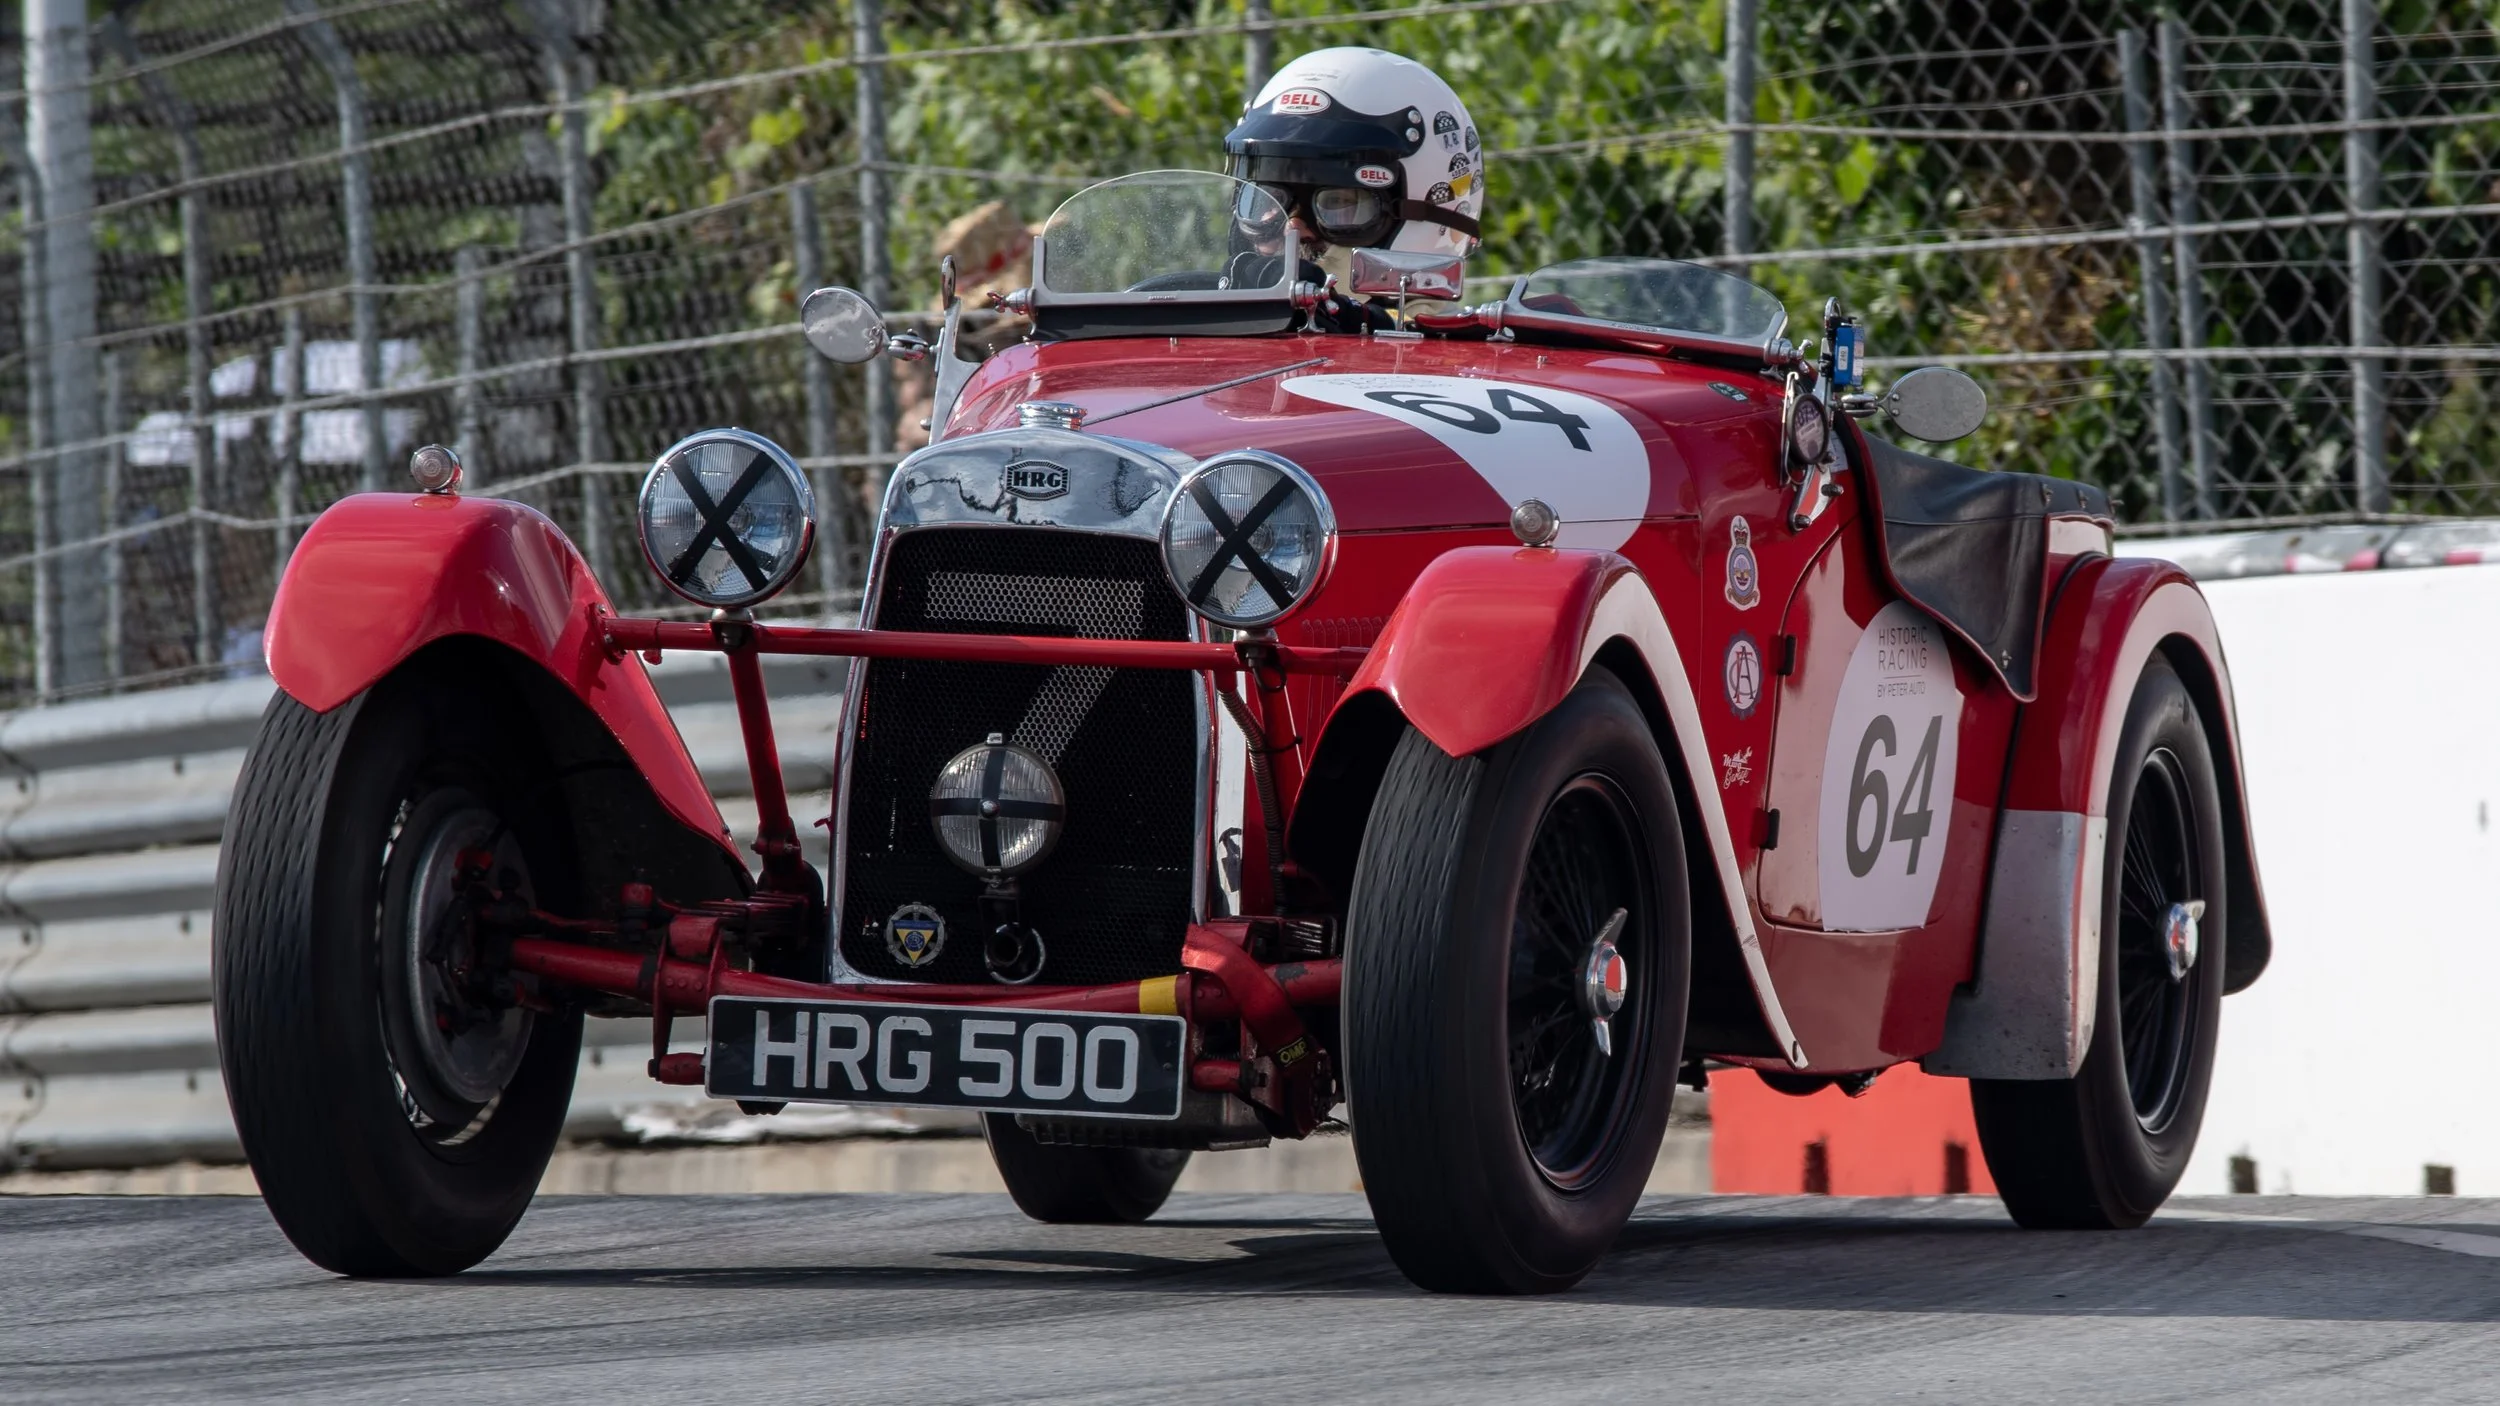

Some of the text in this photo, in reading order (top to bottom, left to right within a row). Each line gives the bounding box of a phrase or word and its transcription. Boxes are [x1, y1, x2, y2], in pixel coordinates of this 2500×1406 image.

[1280, 94, 1320, 106] BELL
[1360, 169, 1389, 181] BELL
[1364, 388, 1593, 453] 64
[1013, 471, 1062, 488] HRG
[1878, 626, 1928, 646] HISTORIC
[1878, 647, 1928, 671] RACING
[1877, 681, 1926, 698] BY PETER AUTO
[1846, 714, 1943, 878] 64
[753, 1009, 1140, 1103] HRG 500
[1280, 1041, 1305, 1063] OMP
